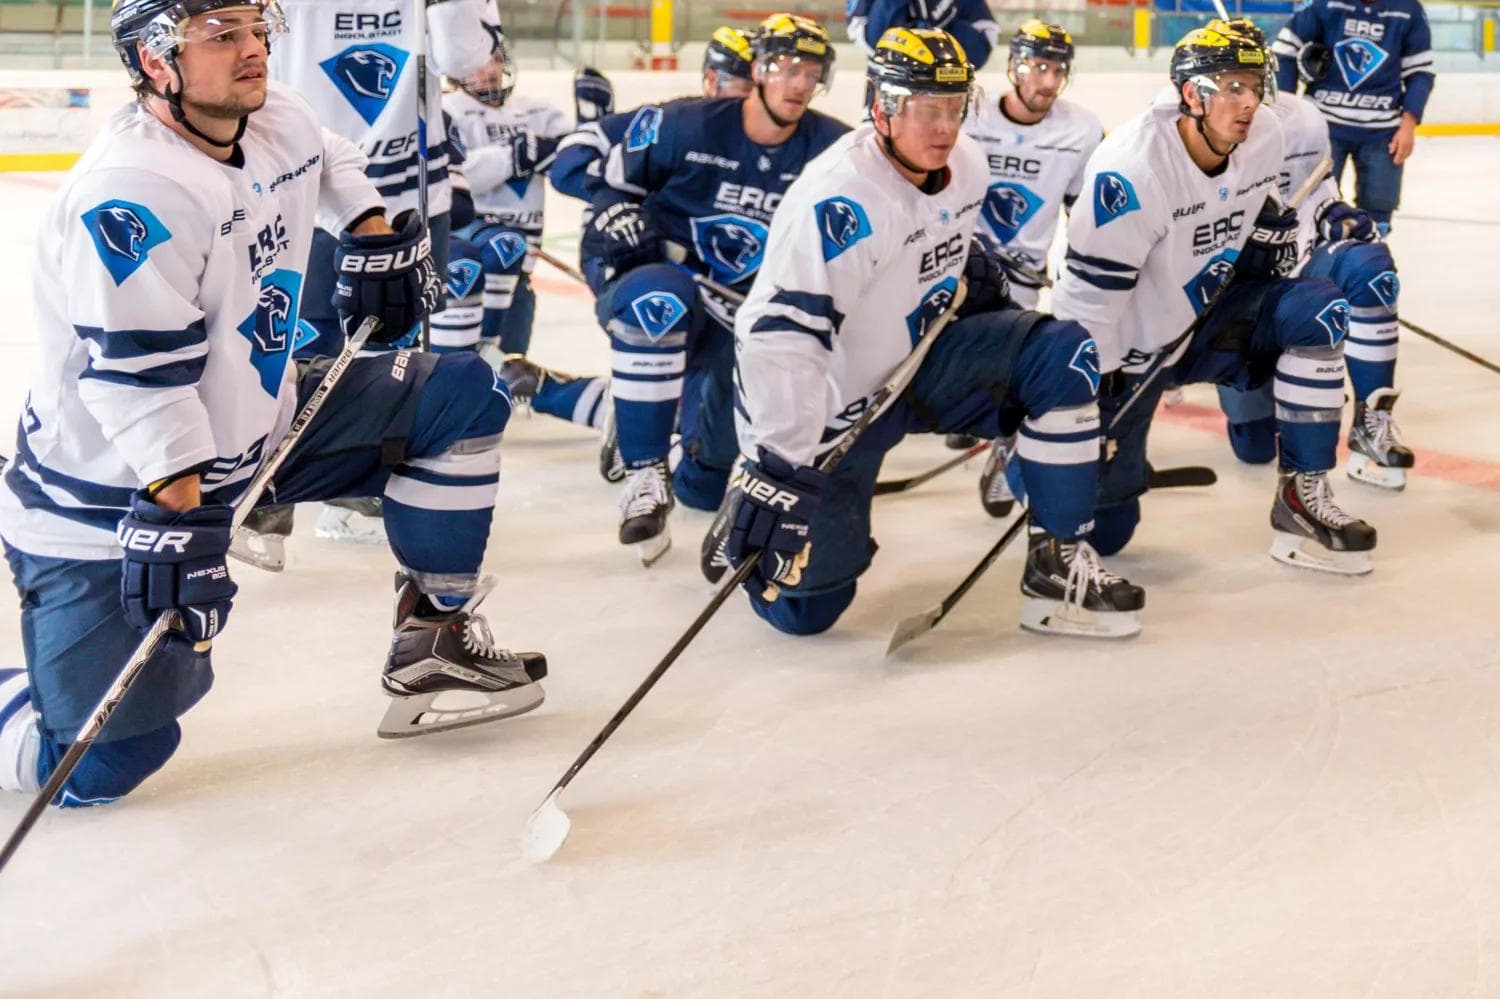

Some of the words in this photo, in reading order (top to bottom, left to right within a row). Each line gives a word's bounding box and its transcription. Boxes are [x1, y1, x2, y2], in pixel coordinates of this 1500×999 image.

[334, 11, 402, 31] ERC
[1344, 19, 1385, 37] ERC
[1314, 90, 1393, 110] BAUER
[987, 154, 1042, 175] ERC
[1192, 209, 1246, 248] ERC
[340, 231, 432, 273] BAUE
[919, 232, 964, 274] ERC
[738, 472, 800, 512] UER
[116, 521, 193, 553] UER
[187, 565, 226, 580] NEXUS
